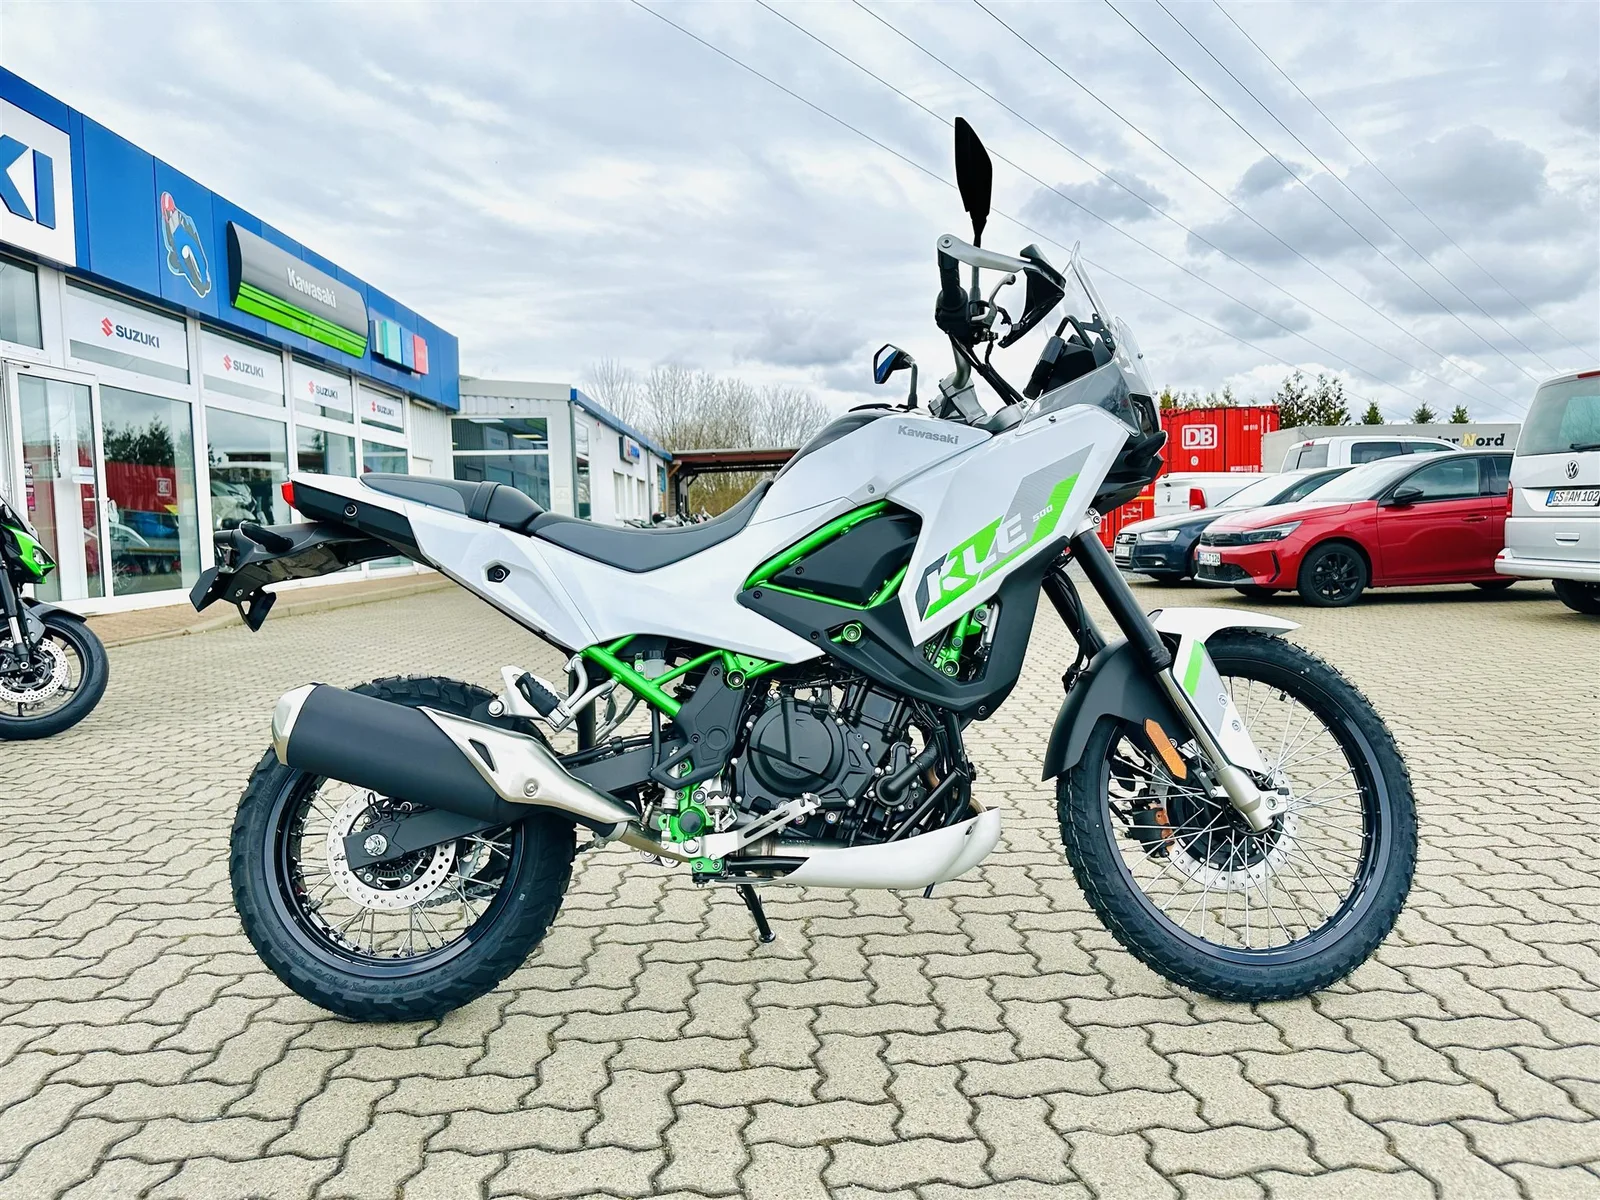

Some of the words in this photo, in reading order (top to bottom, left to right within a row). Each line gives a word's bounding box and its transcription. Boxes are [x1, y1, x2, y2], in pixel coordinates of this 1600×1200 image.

[287, 266, 337, 309] Kawasaki
[115, 324, 160, 348] SUZUKI
[232, 360, 264, 378] SUZUKI
[315, 385, 338, 400] SUZUKI
[897, 425, 960, 445] Kawasaki
[1184, 427, 1214, 446] DB
[1461, 432, 1506, 447] Nord
[1552, 491, 1565, 502] GS
[1567, 491, 1582, 502] AM
[1581, 490, 1600, 502] 102
[924, 512, 1028, 600] KLE
[1031, 504, 1054, 523] 500
